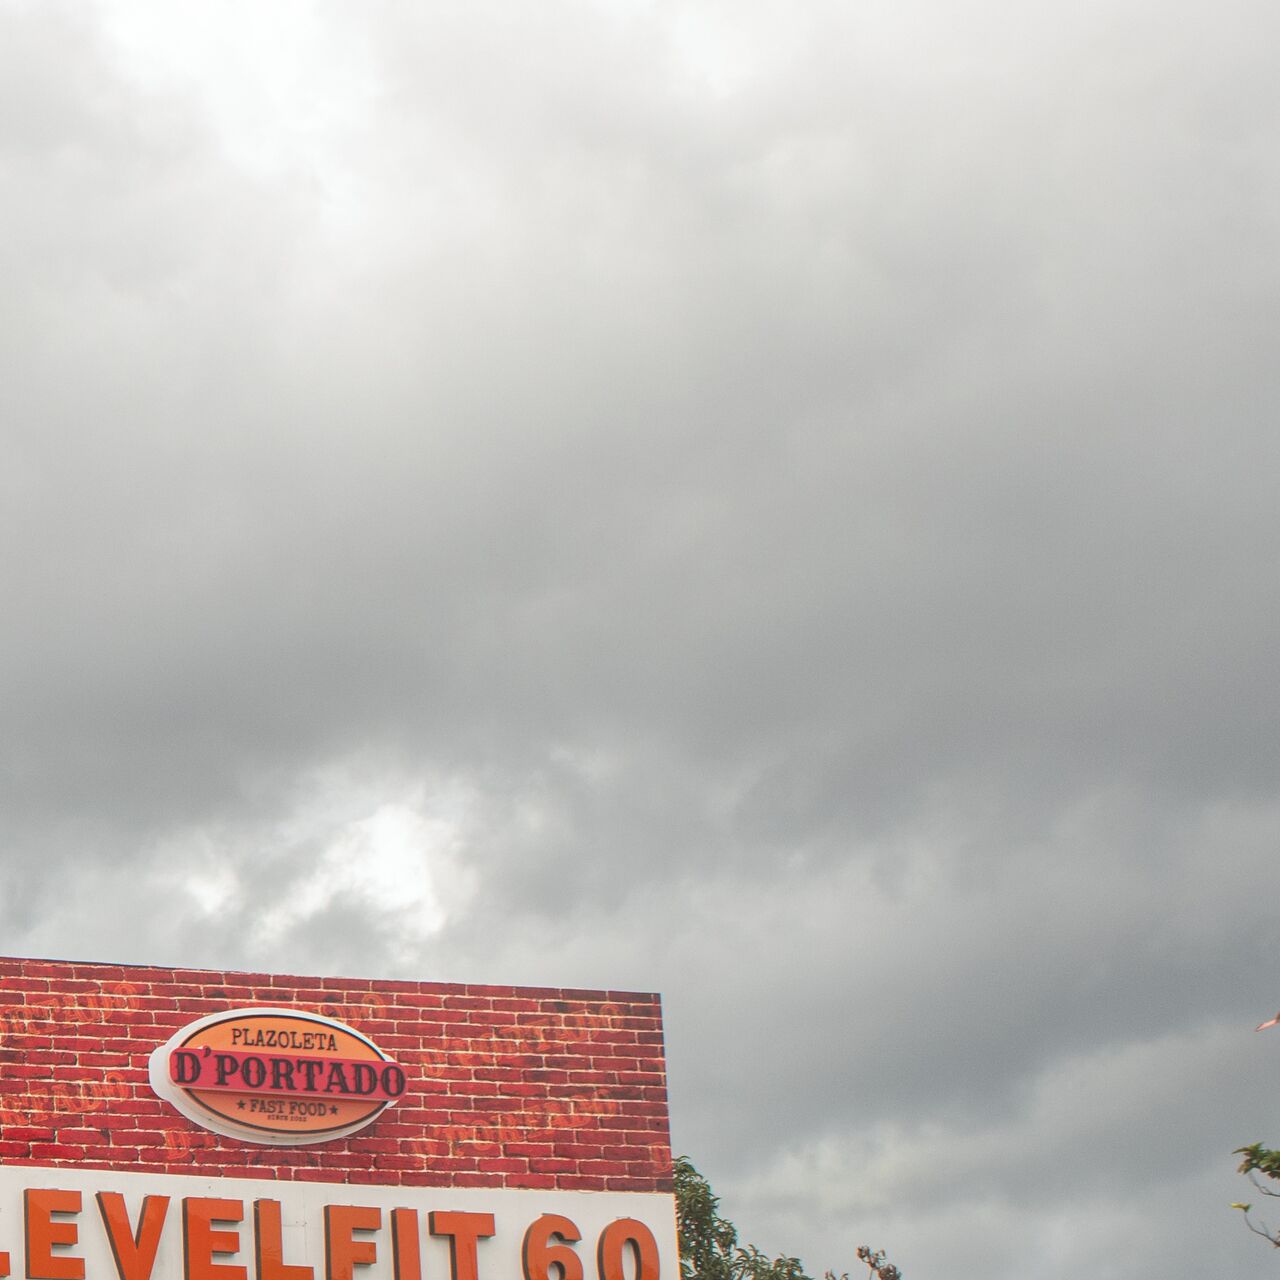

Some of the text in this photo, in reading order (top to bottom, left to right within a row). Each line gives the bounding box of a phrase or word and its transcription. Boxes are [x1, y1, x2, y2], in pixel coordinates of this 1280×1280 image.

[231, 1028, 338, 1051] PLAZOLETA
[175, 1045, 406, 1098] D'PORTADO
[250, 1099, 327, 1116] FAST FOOD
